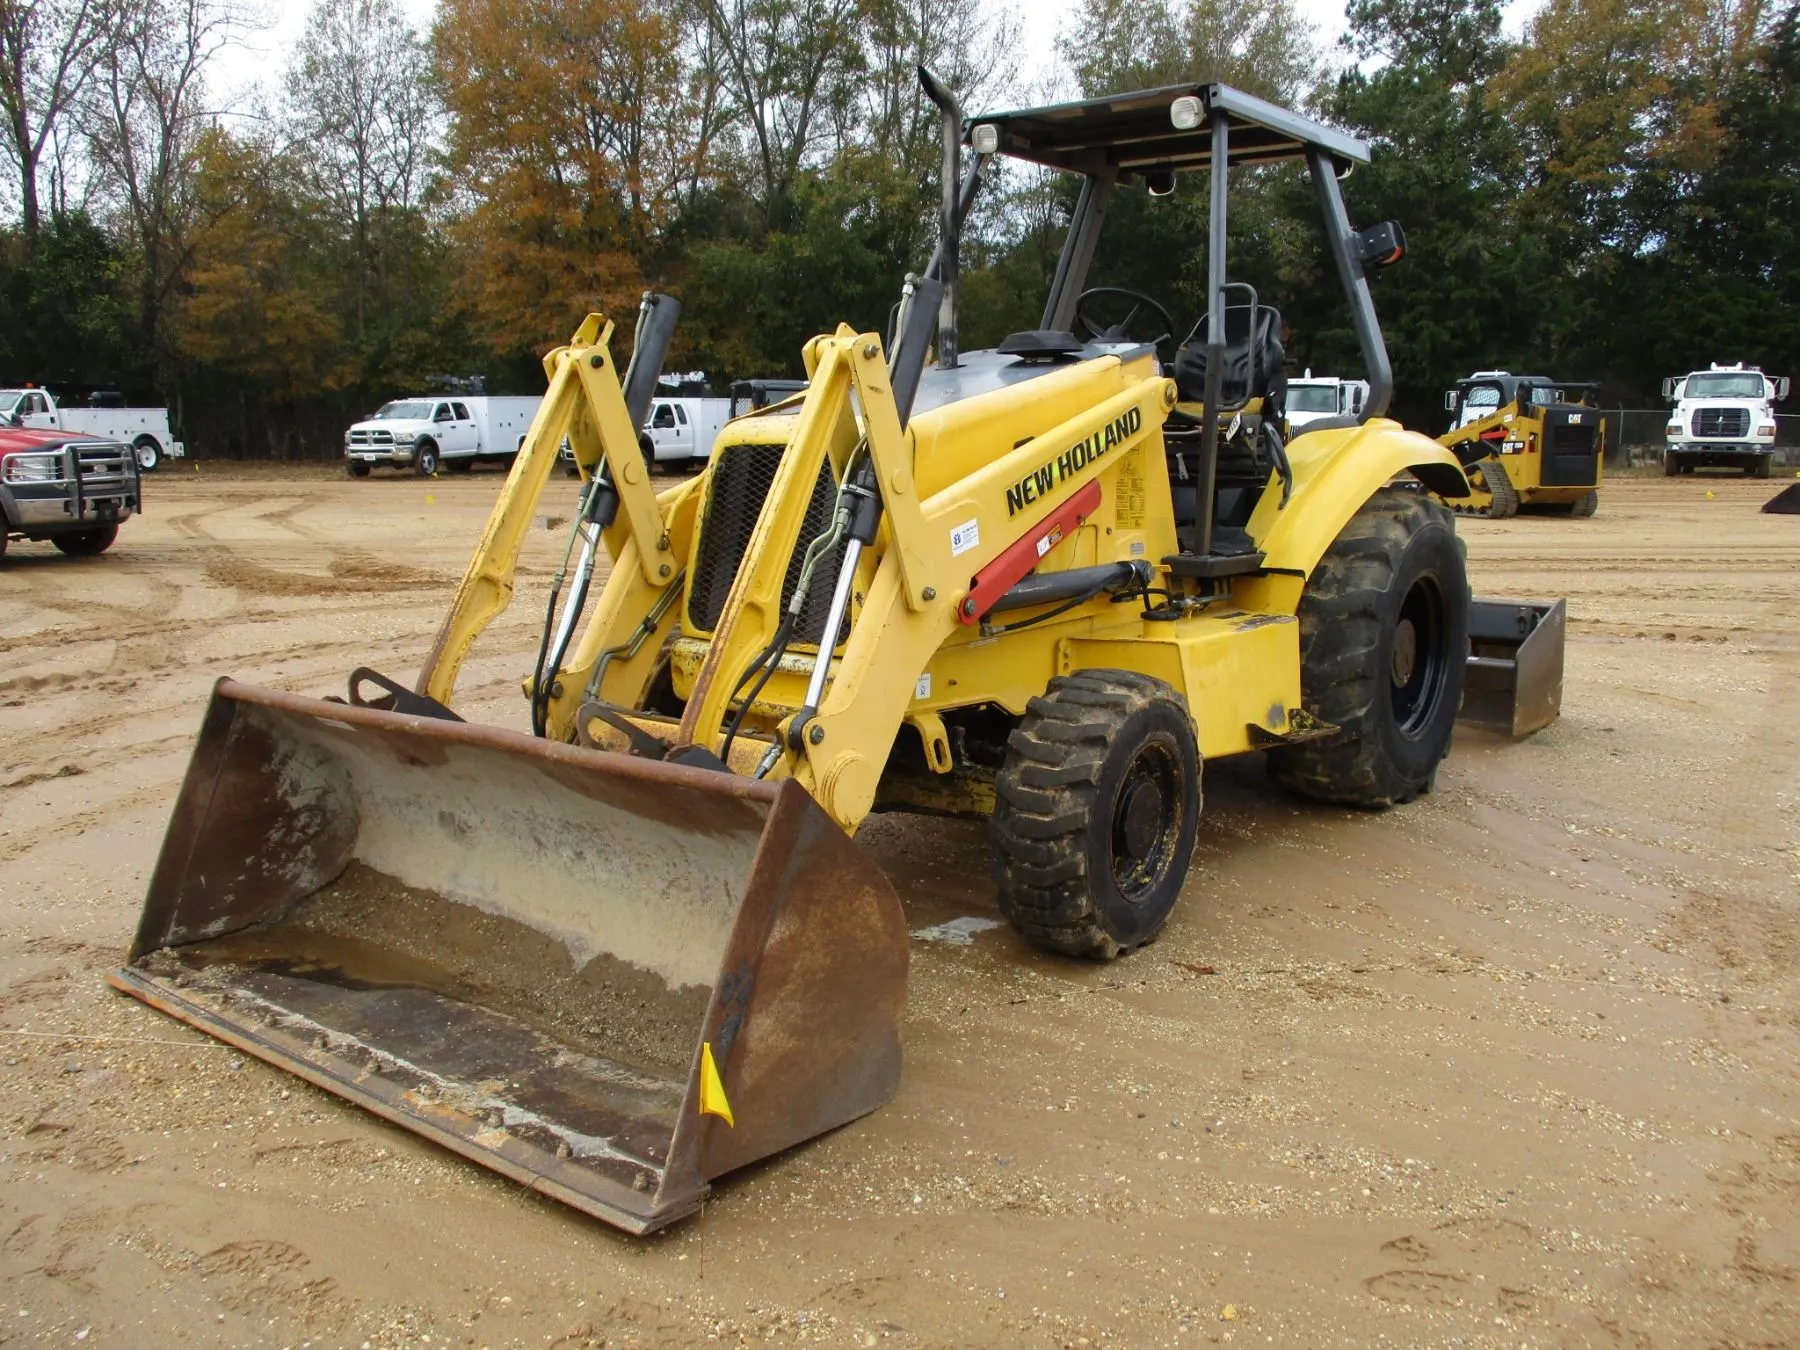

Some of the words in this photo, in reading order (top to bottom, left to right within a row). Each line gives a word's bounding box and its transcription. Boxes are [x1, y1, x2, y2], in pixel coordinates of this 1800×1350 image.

[1568, 413, 1582, 424] CAT
[1502, 442, 1514, 454] CAT
[1006, 462, 1053, 516] NEW
[1058, 406, 1141, 482] HOLLAND
